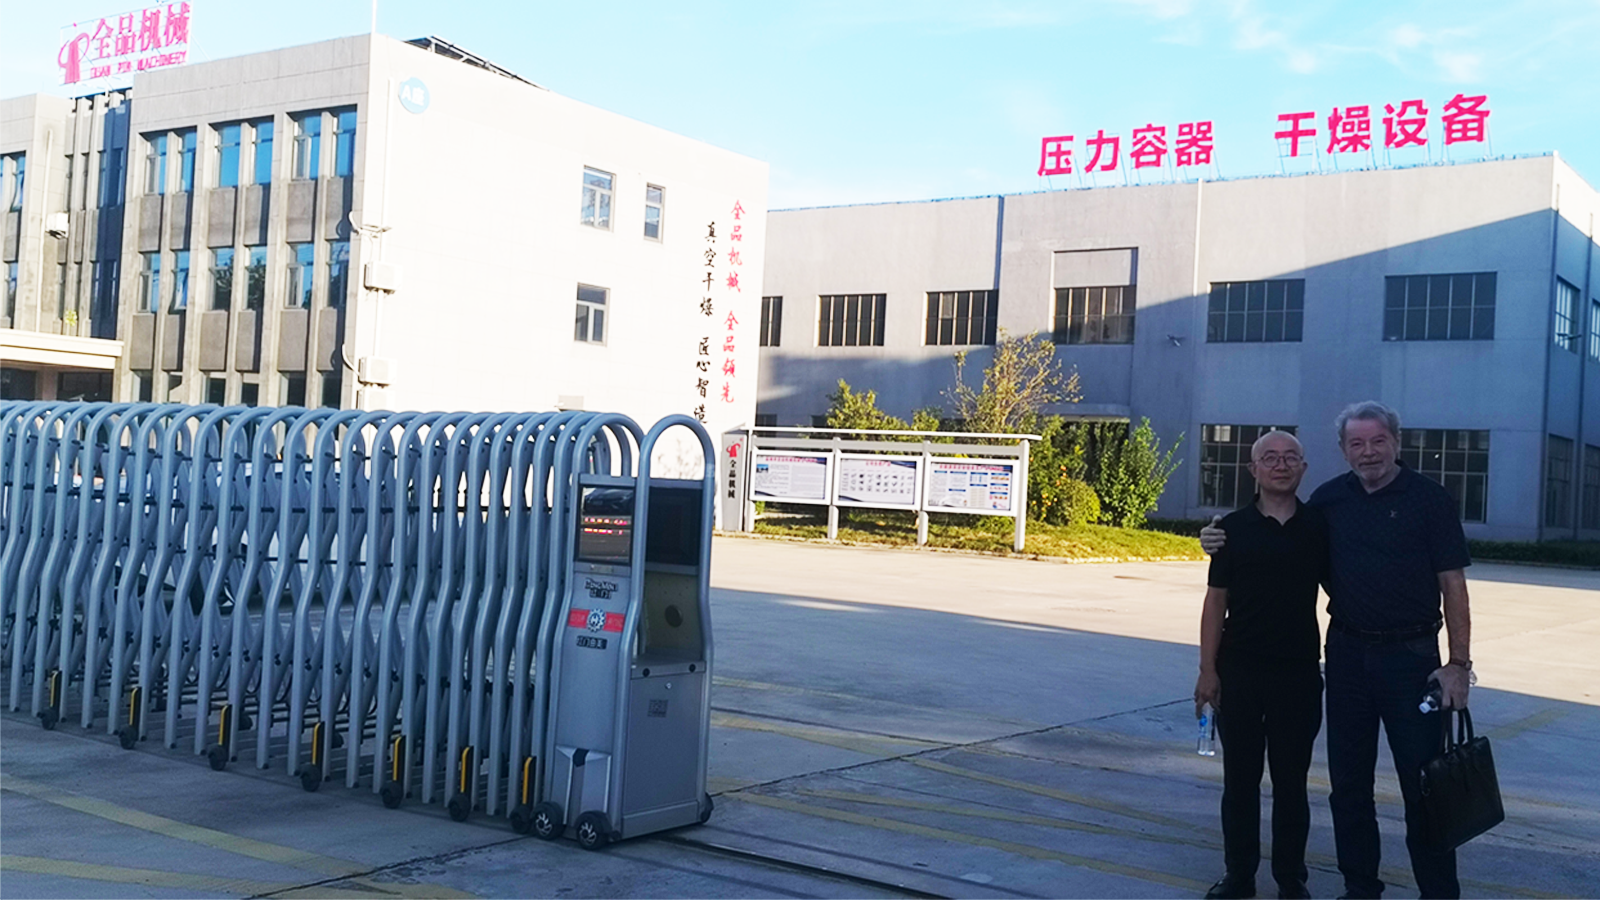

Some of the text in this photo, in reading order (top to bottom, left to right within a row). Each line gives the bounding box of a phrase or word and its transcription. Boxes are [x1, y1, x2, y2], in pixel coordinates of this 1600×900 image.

[91, 2, 190, 60] 全品机械
[1037, 94, 1490, 176] 压力容器 干燥设备
[726, 200, 746, 293] 全品机械
[694, 221, 717, 424] 真空干燥 匠心智造
[727, 459, 737, 499] 全品机械
